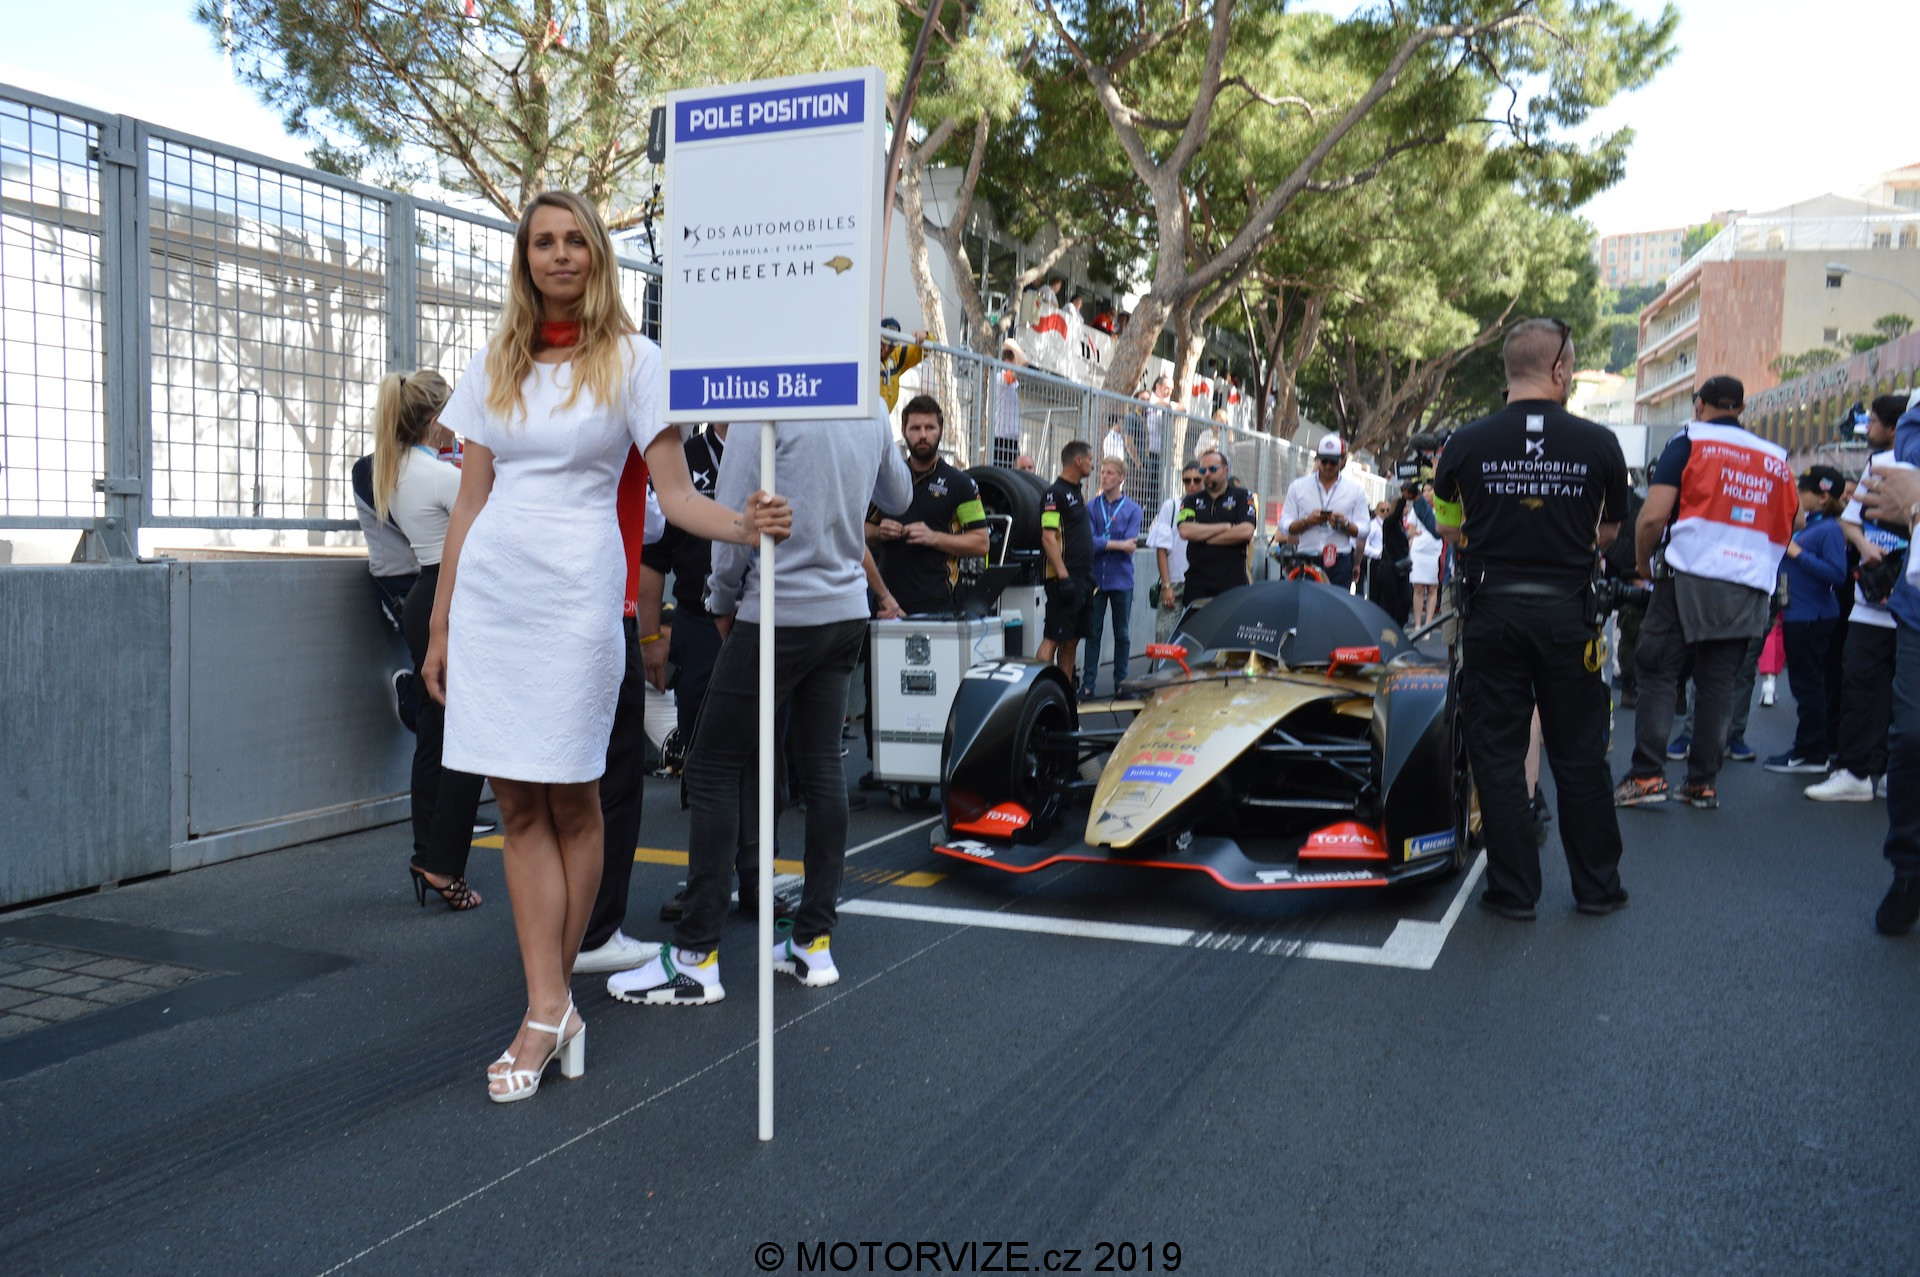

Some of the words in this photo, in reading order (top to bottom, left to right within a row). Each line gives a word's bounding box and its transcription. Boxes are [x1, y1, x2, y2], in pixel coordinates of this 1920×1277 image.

[690, 104, 743, 132] POLE
[749, 91, 849, 126] POSITION
[707, 227, 726, 240] DS
[732, 215, 856, 238] AUTOMOBILES
[787, 244, 813, 252] TEAM
[683, 261, 814, 283] TECHEETAH
[702, 375, 770, 406] Julius
[777, 373, 823, 398] Bär
[1482, 460, 1498, 473] DS
[1500, 460, 1588, 475] AUTOMOBILES
[1485, 482, 1583, 497] TECHEETAH
[1723, 483, 1768, 506] HOLDER
[1336, 652, 1359, 661] TOTAL
[964, 661, 1027, 683] 25
[1129, 751, 1196, 765] ABB
[986, 810, 1024, 824] TOTAL
[1313, 833, 1375, 846] TOTAL
